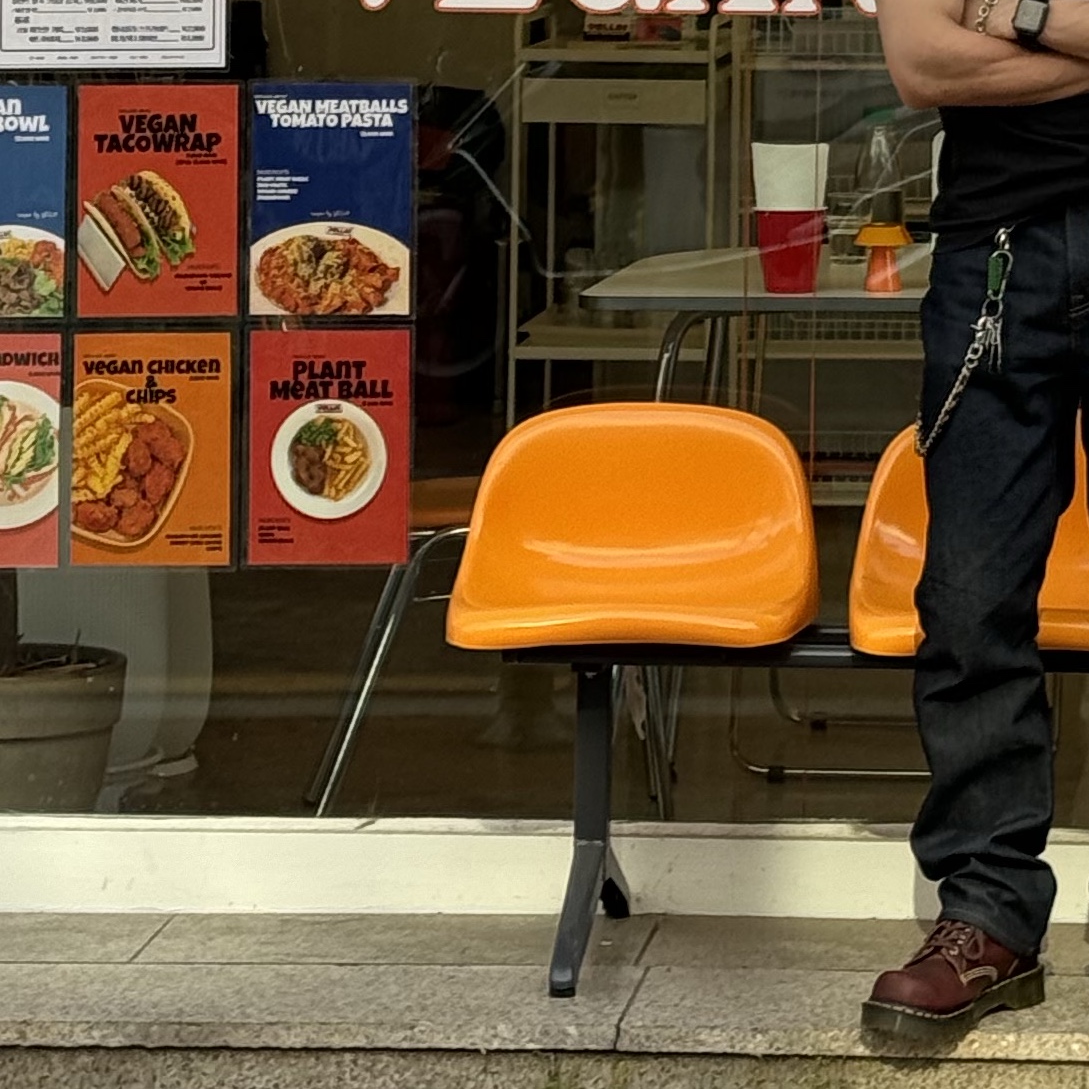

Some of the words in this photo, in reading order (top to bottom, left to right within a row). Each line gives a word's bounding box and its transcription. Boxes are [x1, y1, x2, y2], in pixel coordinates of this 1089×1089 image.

[255, 99, 312, 114] VEGAN
[315, 98, 408, 114] MEATBALLS
[118, 113, 197, 133] VEGAN
[270, 113, 338, 128] TOMATO
[341, 113, 394, 128] PASTA
[93, 132, 222, 154] TACOWRAP
[0, 351, 60, 368] DWICH
[126, 388, 176, 405] CHIPS
[338, 379, 393, 399] BALL
